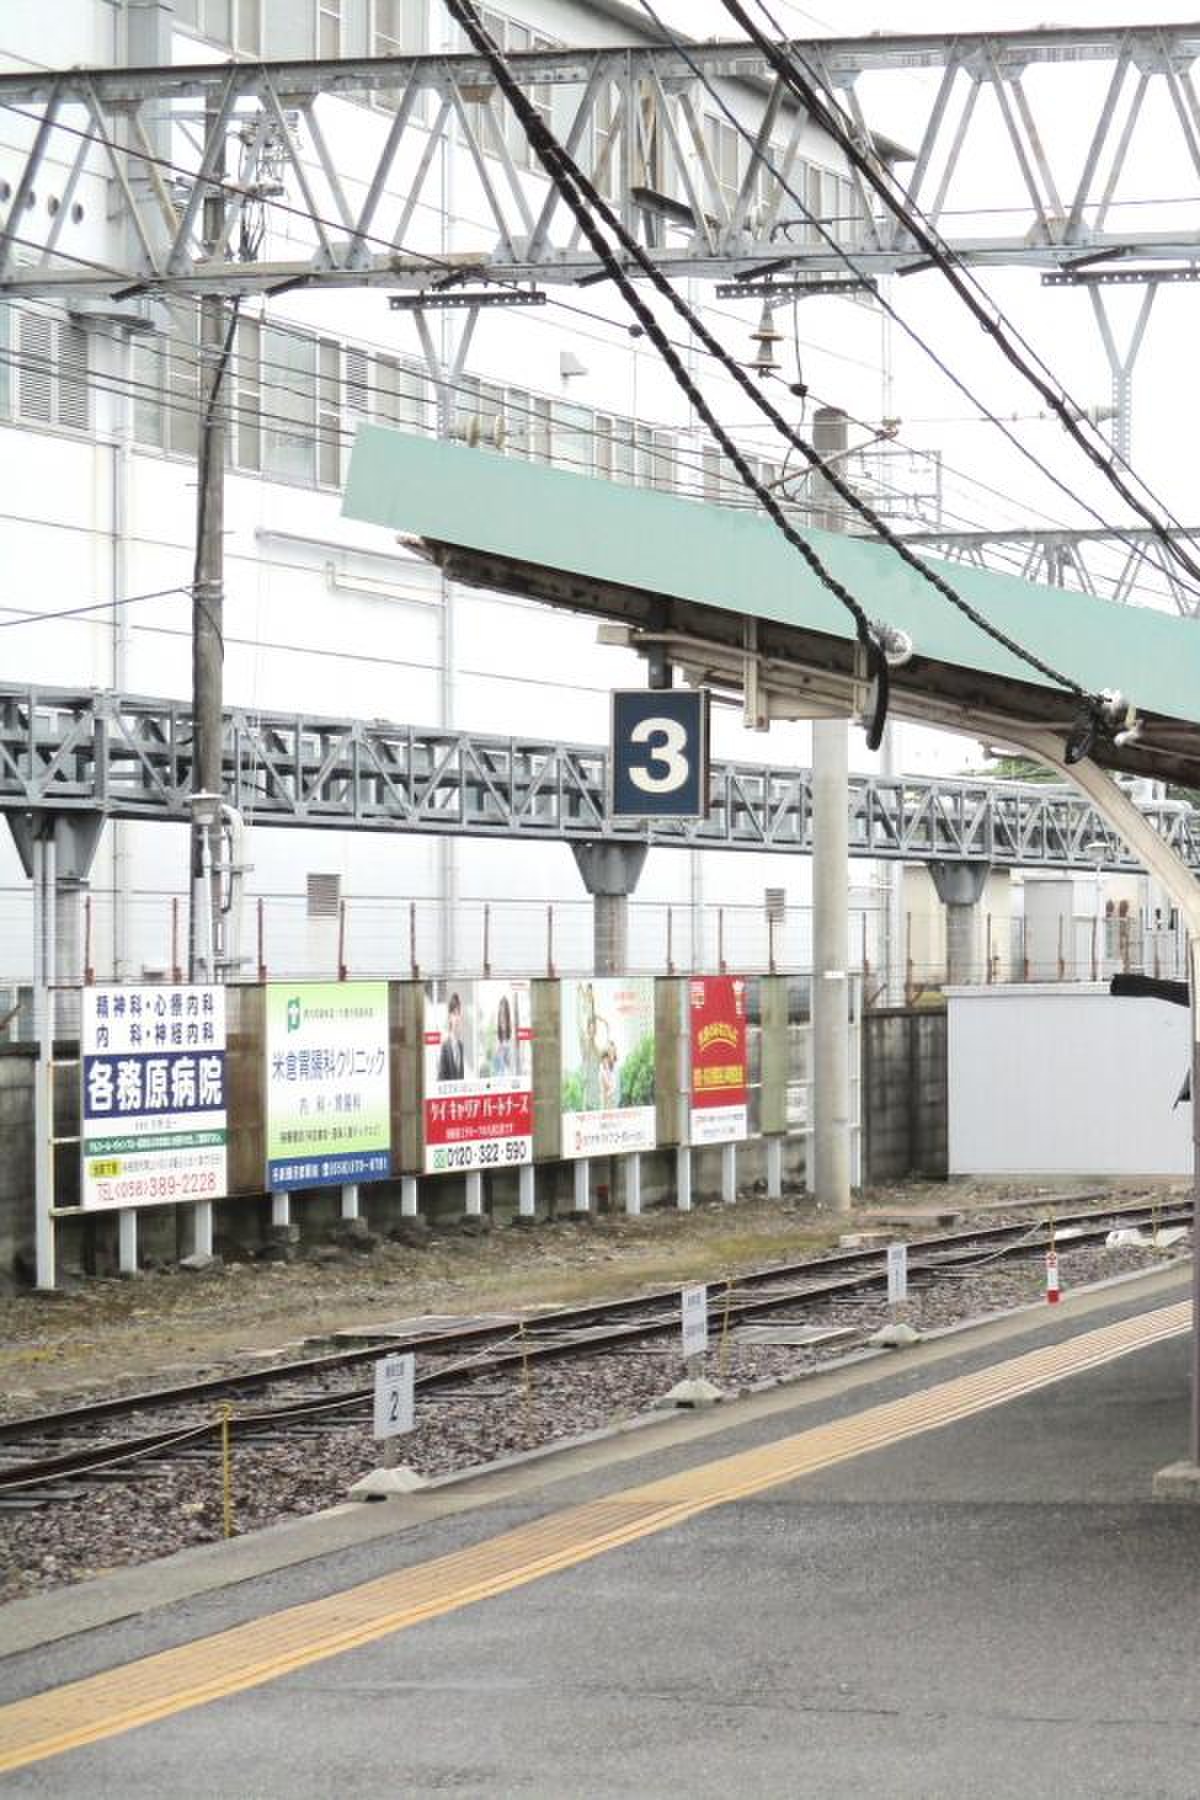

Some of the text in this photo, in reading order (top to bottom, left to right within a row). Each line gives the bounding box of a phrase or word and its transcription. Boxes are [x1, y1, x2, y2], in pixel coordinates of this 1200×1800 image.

[629, 717, 689, 793] 3
[88, 1056, 223, 1112] 各務原病院
[389, 1390, 399, 1422] 2
